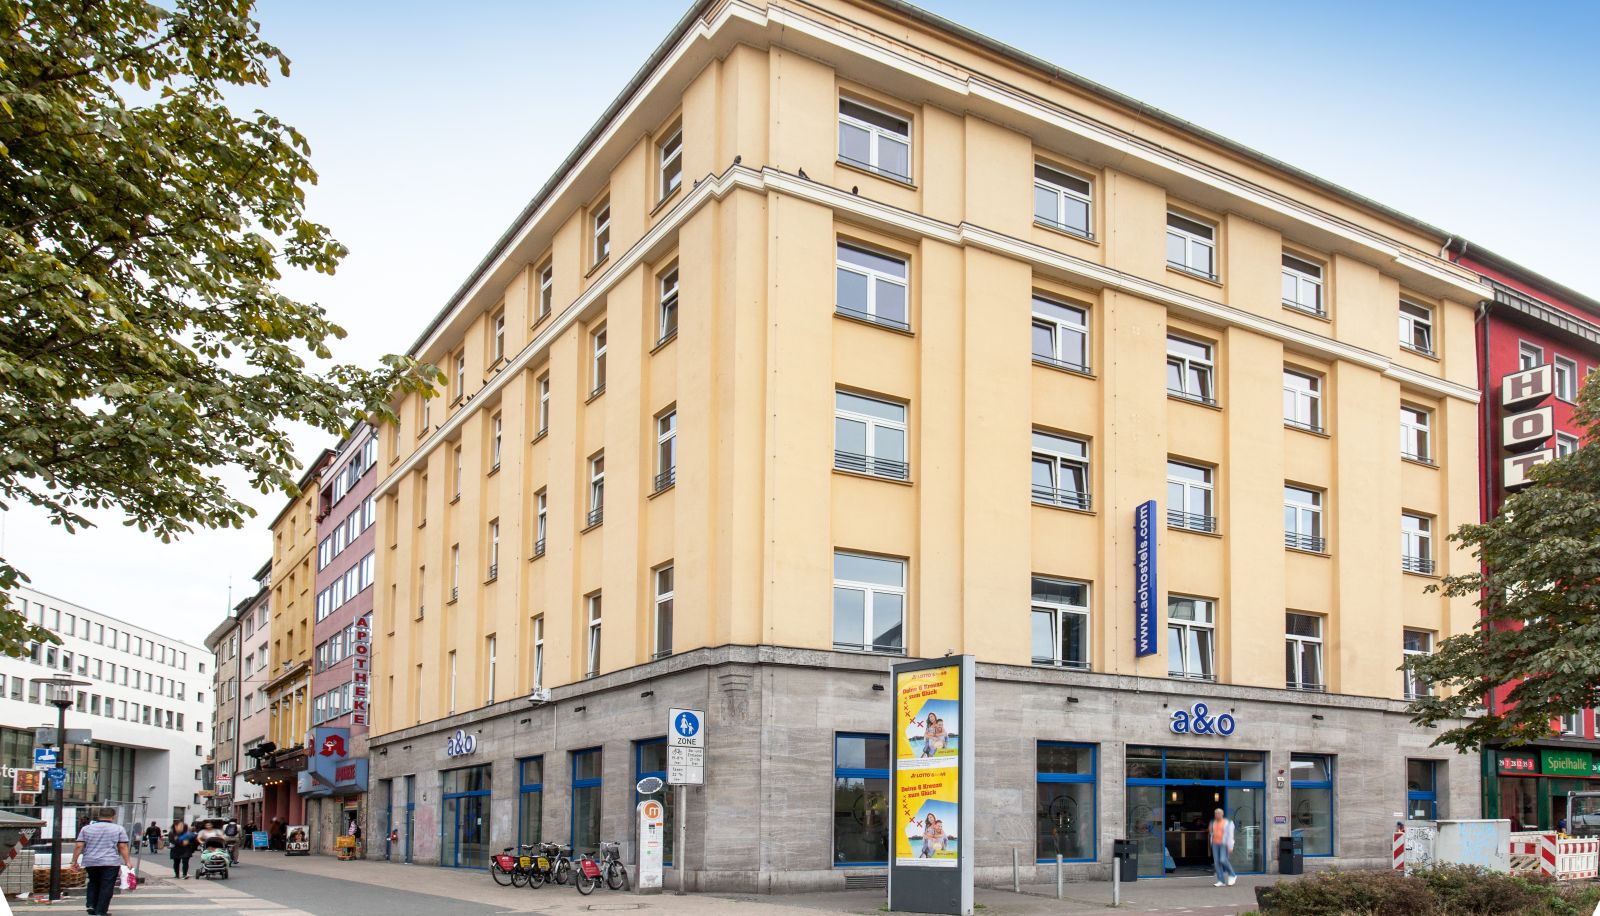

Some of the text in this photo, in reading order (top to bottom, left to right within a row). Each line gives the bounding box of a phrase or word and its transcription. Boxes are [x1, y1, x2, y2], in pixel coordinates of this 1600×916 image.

[1138, 504, 1149, 653] www.aohostels.com
[354, 617, 368, 724] APOTHEKE
[1170, 702, 1236, 736] a&o
[447, 729, 476, 756] a&o
[1548, 757, 1587, 771] Spielhalle
